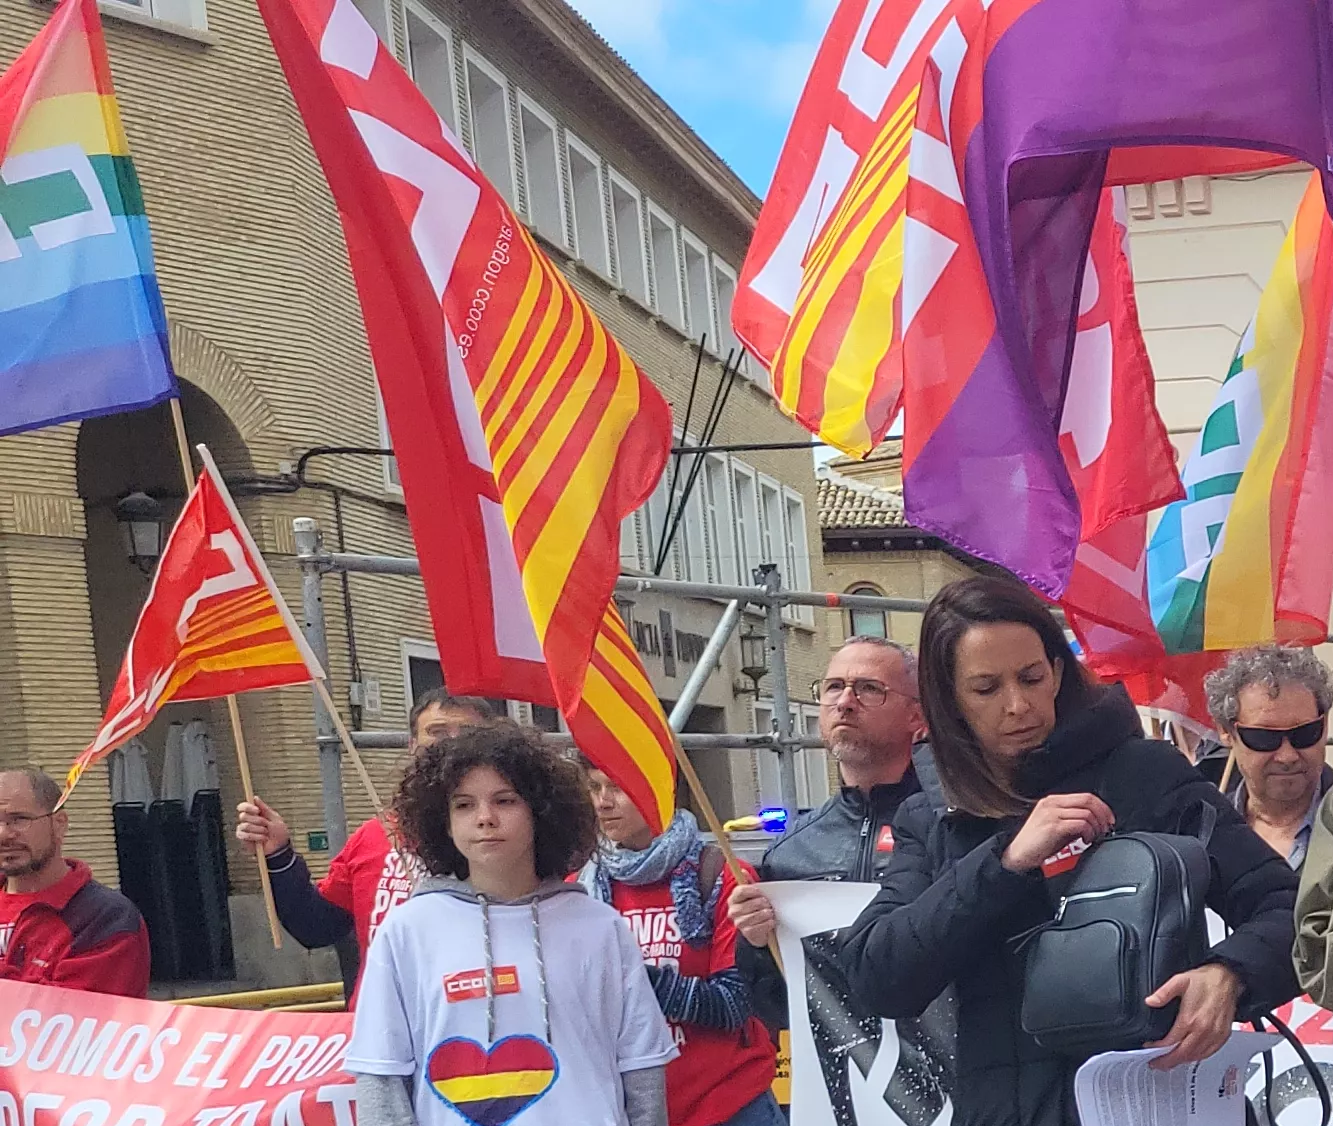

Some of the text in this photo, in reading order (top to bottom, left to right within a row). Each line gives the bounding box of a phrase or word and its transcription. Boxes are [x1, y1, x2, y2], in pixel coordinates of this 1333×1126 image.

[446, 977, 487, 993] CCO
[0, 1009, 180, 1084] SOMOS
[176, 1031, 240, 1088] EL
